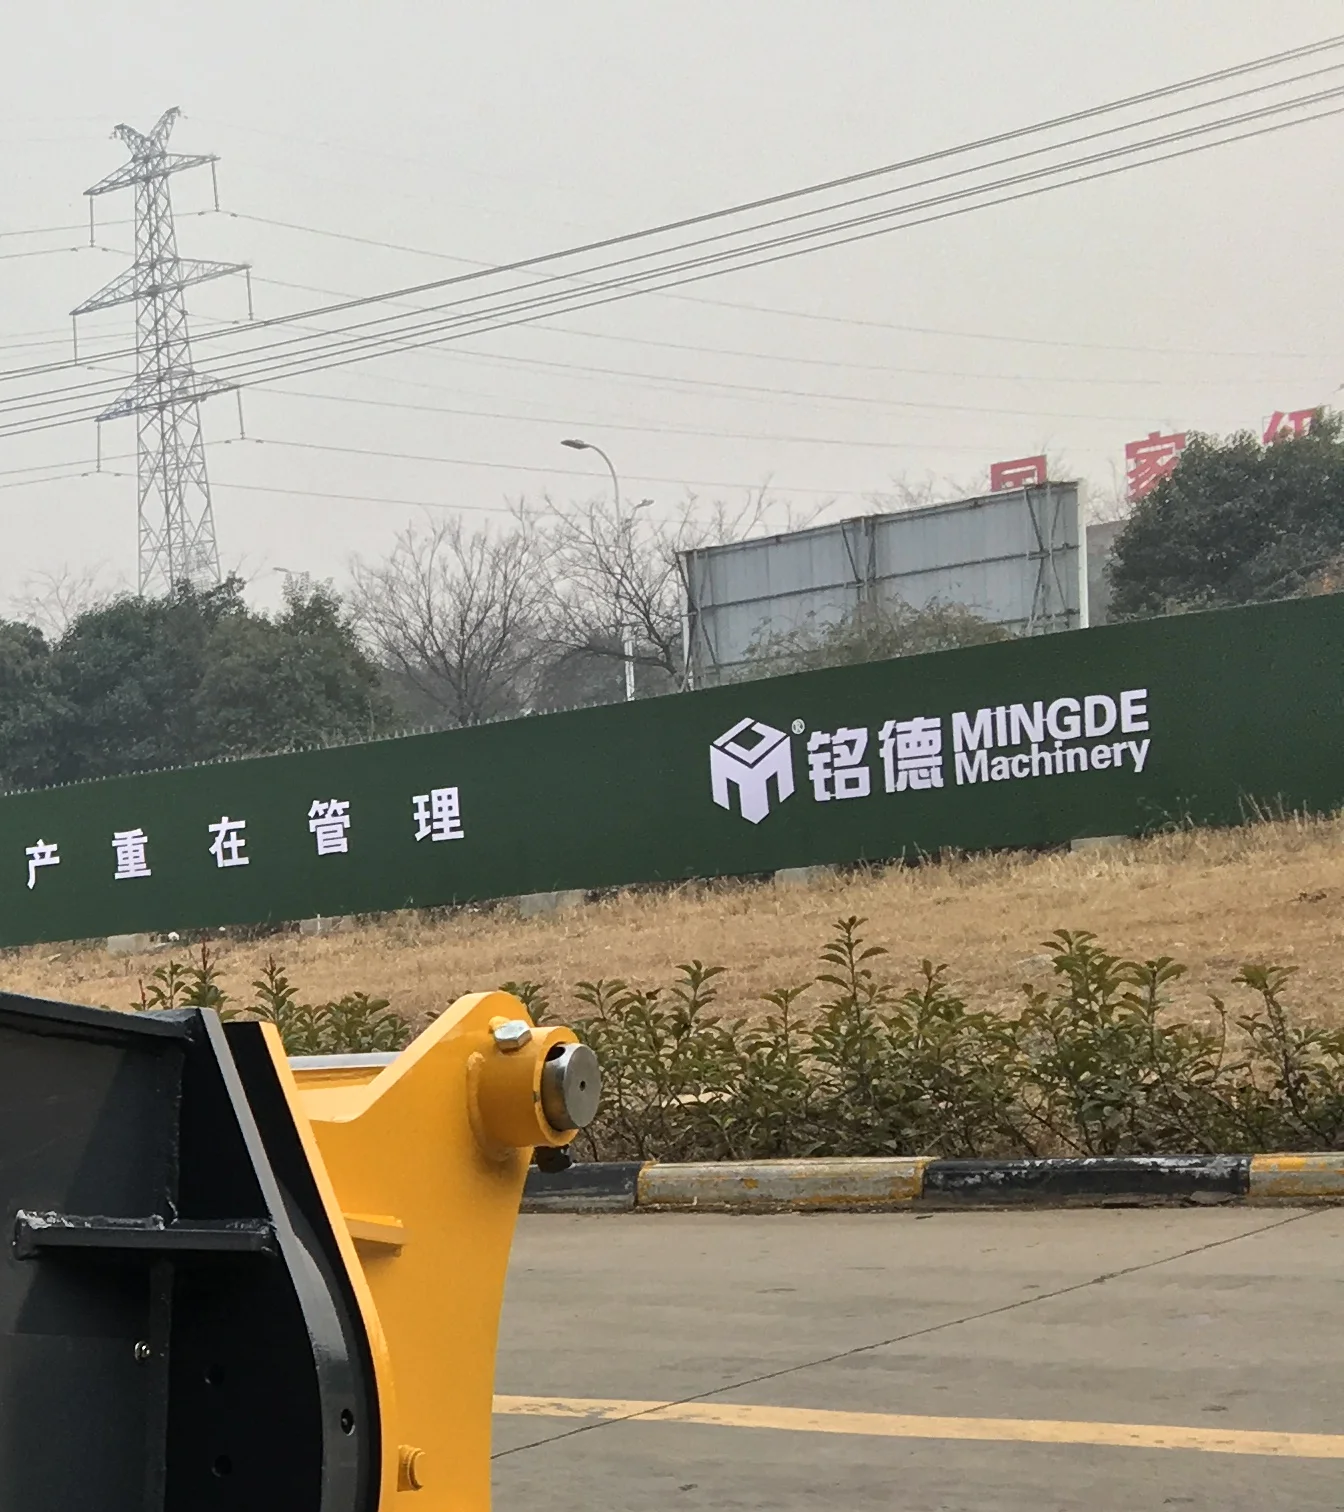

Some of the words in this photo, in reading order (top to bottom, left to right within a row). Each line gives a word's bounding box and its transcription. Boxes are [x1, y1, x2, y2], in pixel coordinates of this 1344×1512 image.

[952, 688, 1150, 752] MINGDE
[807, 716, 944, 801] 铭德
[955, 738, 1151, 785] Machinery
